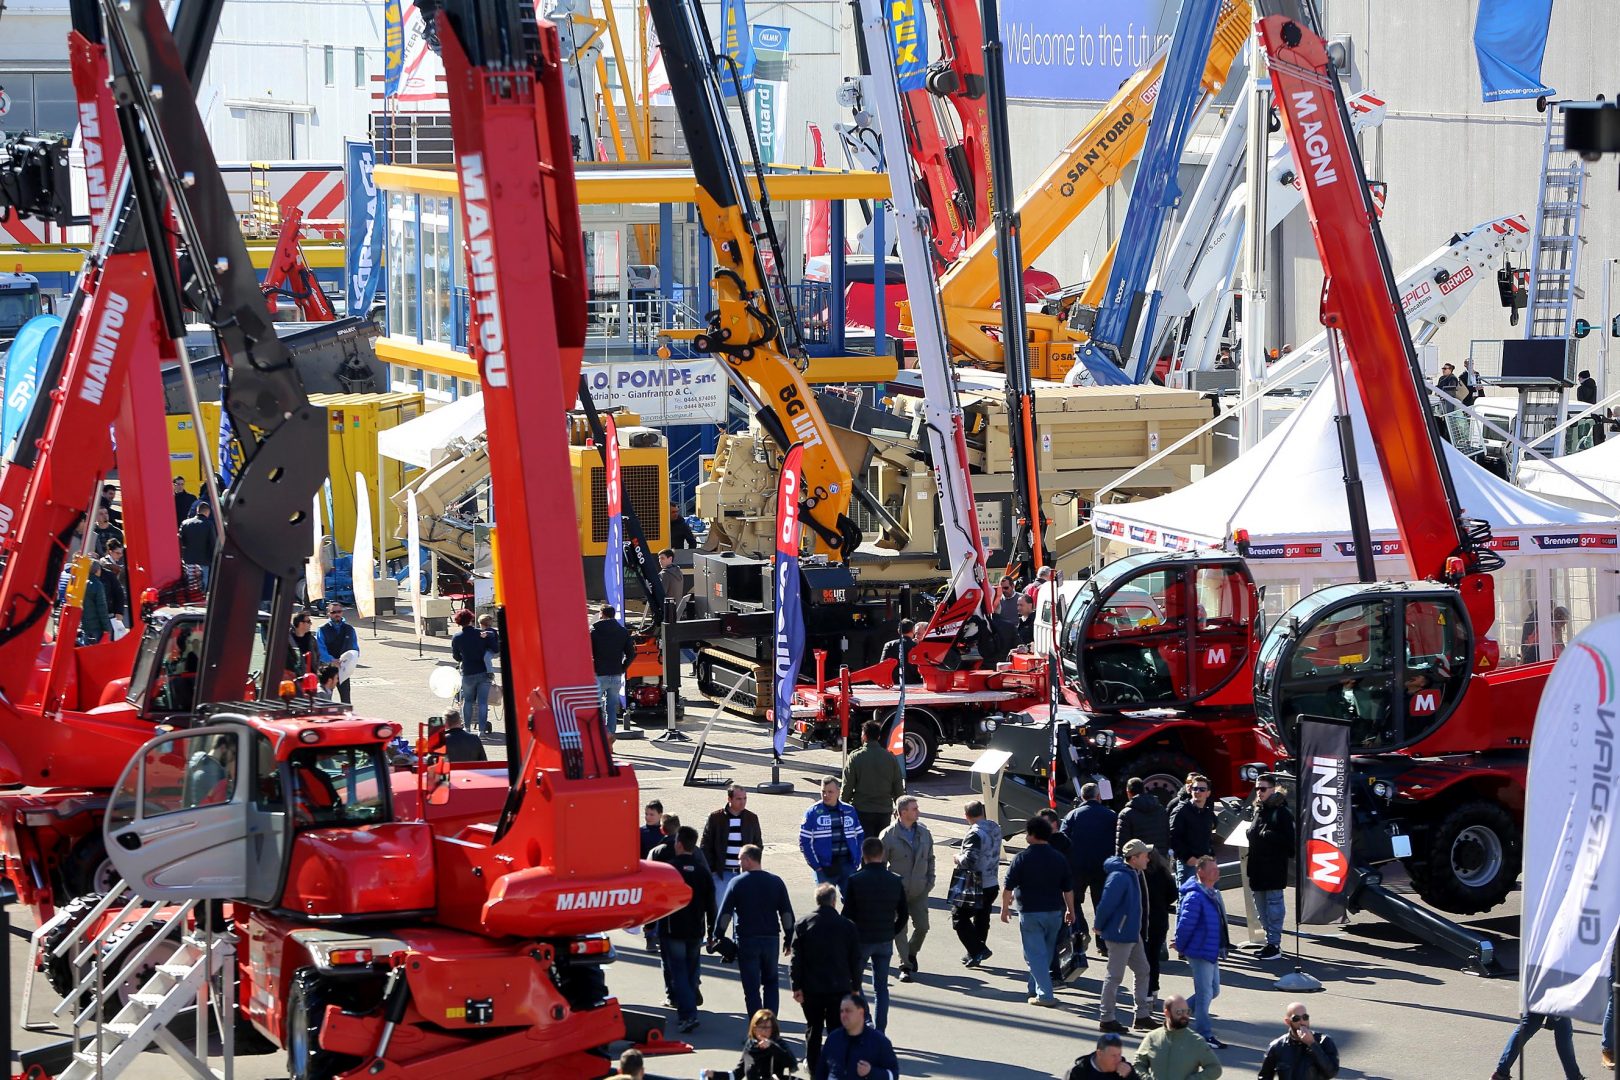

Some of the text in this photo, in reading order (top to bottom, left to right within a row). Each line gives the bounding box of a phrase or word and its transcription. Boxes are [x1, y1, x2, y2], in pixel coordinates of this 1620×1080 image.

[761, 32, 780, 42] NLMK
[1006, 23, 1075, 65] Welcome
[1079, 25, 1094, 66] to
[1098, 23, 1122, 67] the
[1292, 91, 1337, 187] MAGNI
[461, 153, 508, 388] MANITOU
[1440, 267, 1473, 295] ORMIG
[1405, 295, 1432, 316] elocations
[80, 292, 129, 405] MANITOU
[617, 368, 691, 389] POMPE
[695, 373, 717, 385] snc
[628, 387, 674, 400] Gianfranco
[675, 387, 681, 396] &
[1248, 547, 1284, 555] Brennero
[1286, 547, 1300, 557] gru
[1385, 543, 1399, 553] gru
[1544, 537, 1579, 545] Brennero
[1581, 537, 1596, 546] gru
[1207, 648, 1226, 664] M
[1414, 693, 1436, 711] M
[1336, 758, 1346, 848] TELESCOPIC HANDLERS
[1312, 756, 1341, 884] MAGNI
[556, 887, 643, 911] MANITOU
